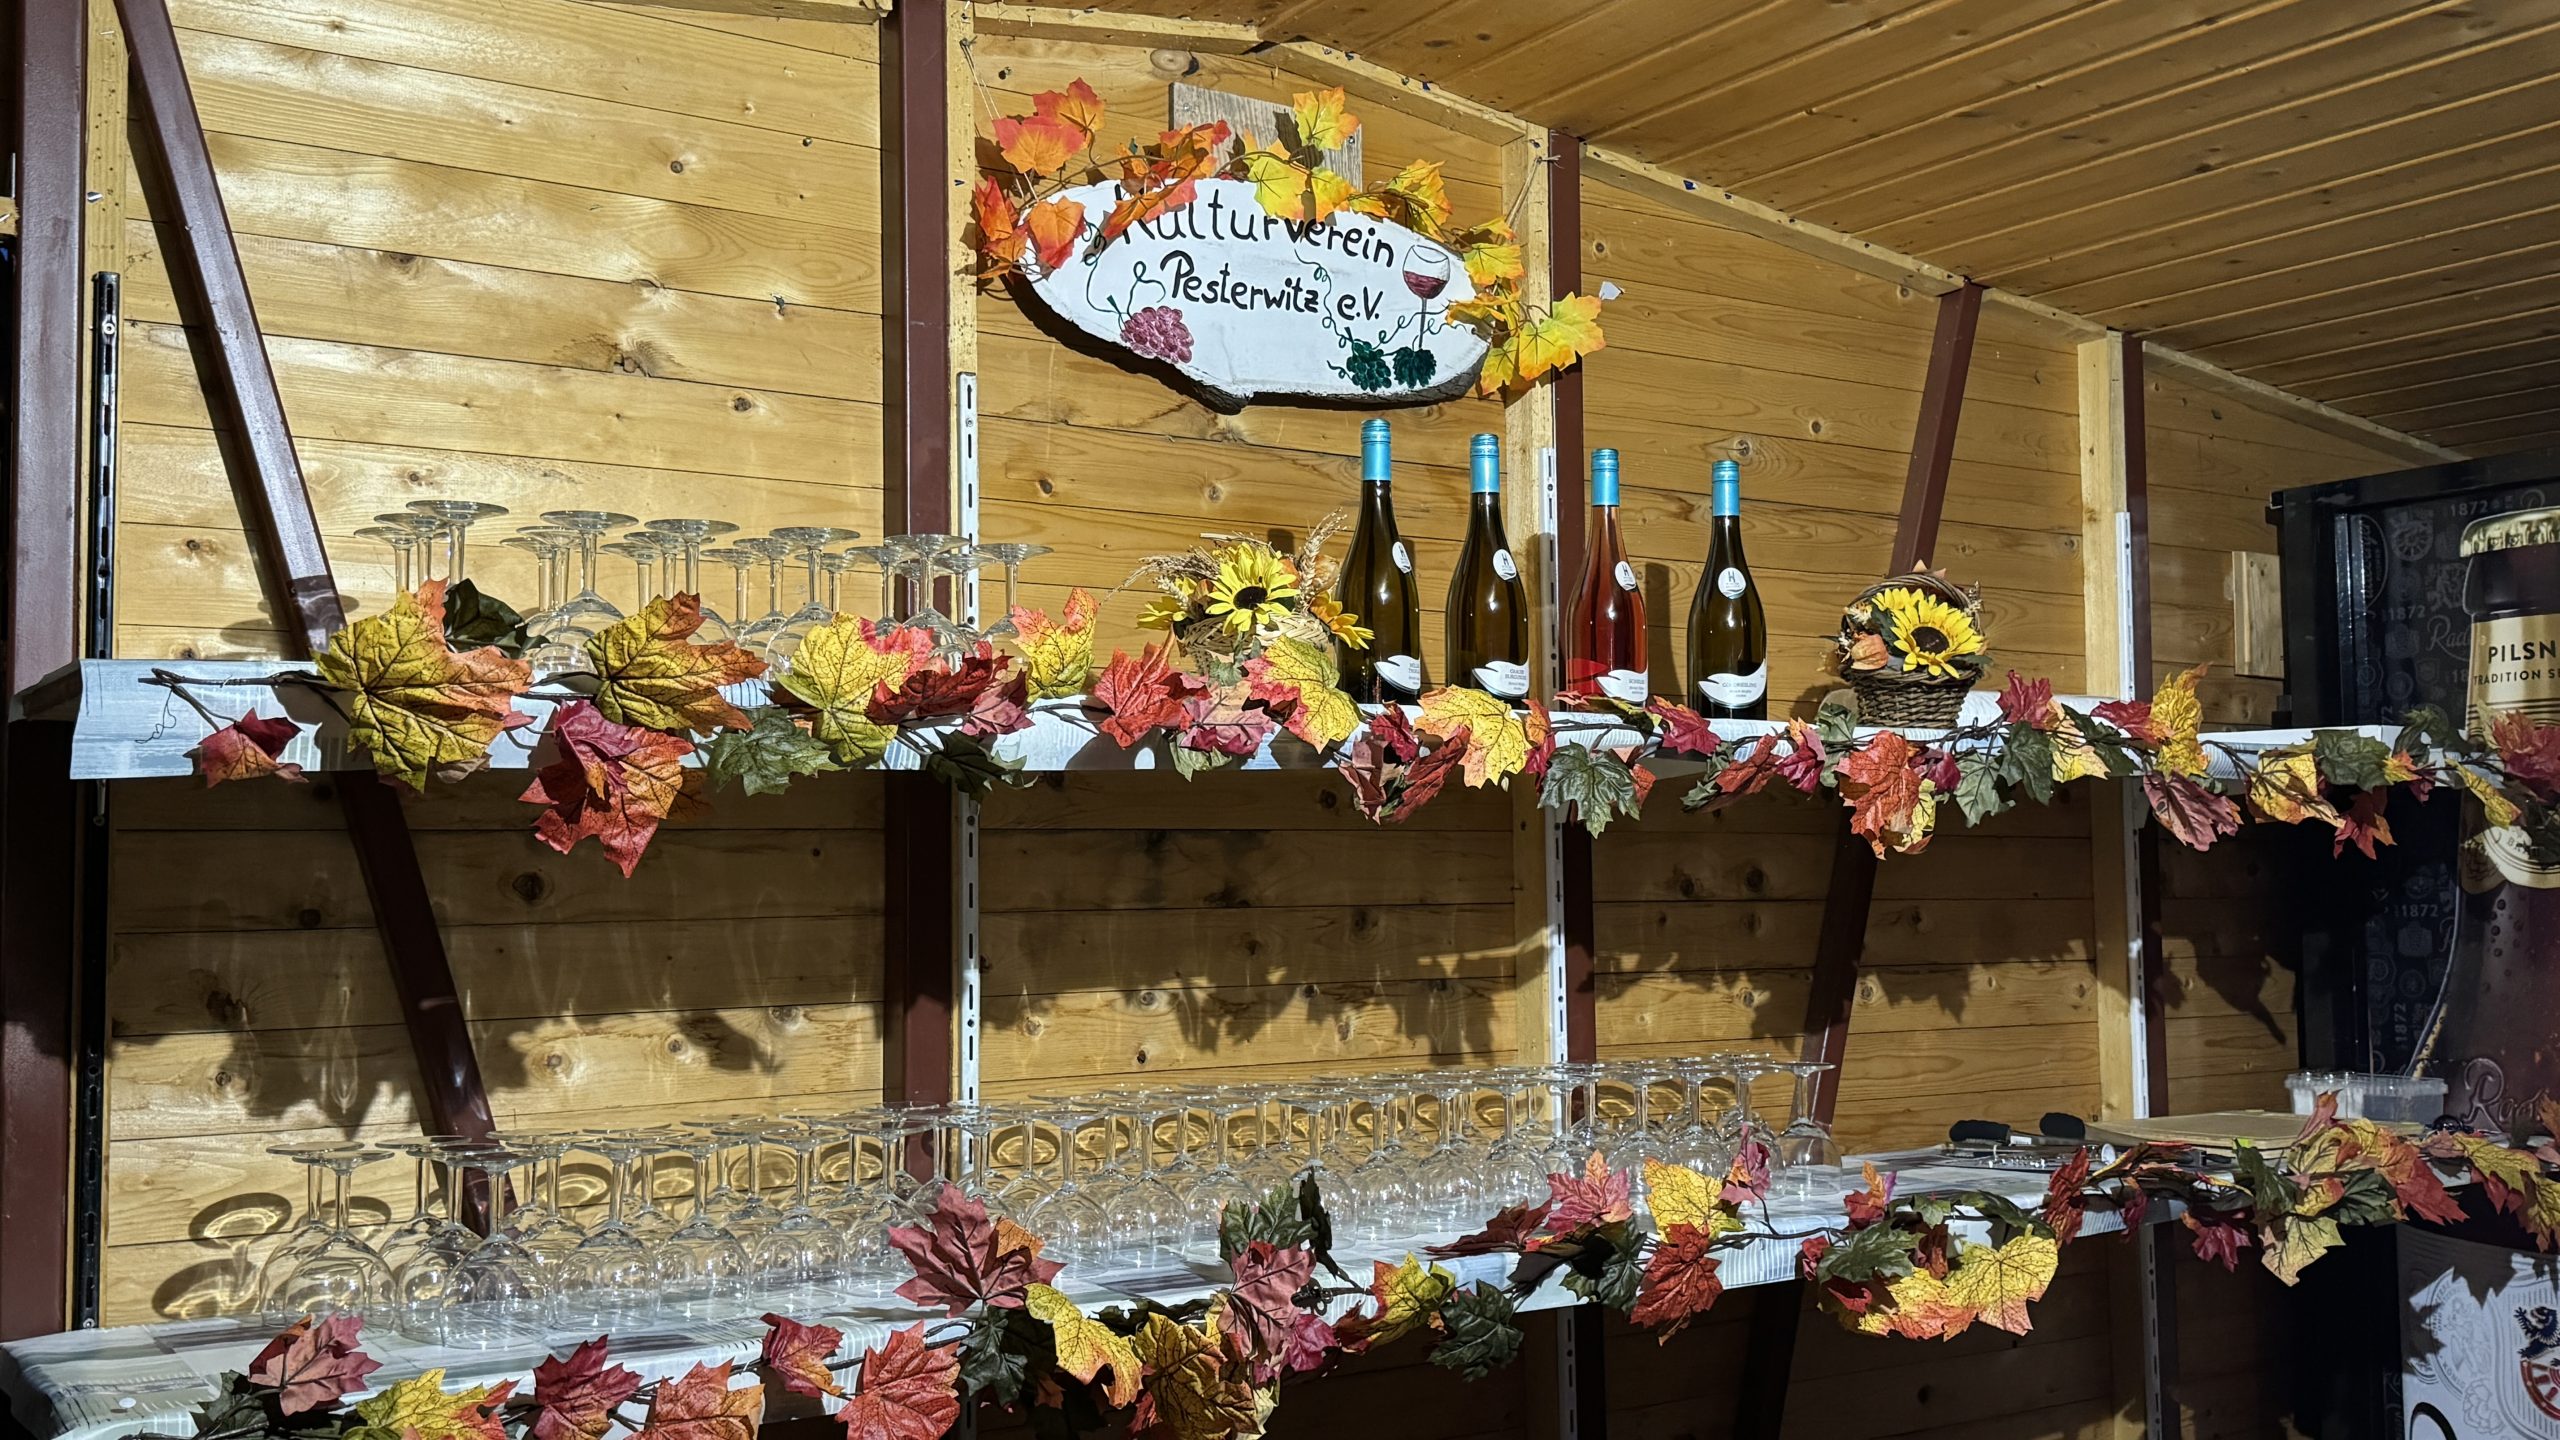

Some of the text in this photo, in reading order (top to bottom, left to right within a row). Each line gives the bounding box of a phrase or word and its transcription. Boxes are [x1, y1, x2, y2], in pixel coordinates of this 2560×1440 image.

[1160, 250, 1384, 320] Pesterwitz e.V.
[2450, 500, 2489, 517] 1872
[1621, 563, 1630, 577] H
[1727, 570, 1736, 583] H
[2473, 670, 2541, 686] TRADITION
[2401, 903, 2439, 918] 1872
[2393, 1002, 2408, 1042] 1872
